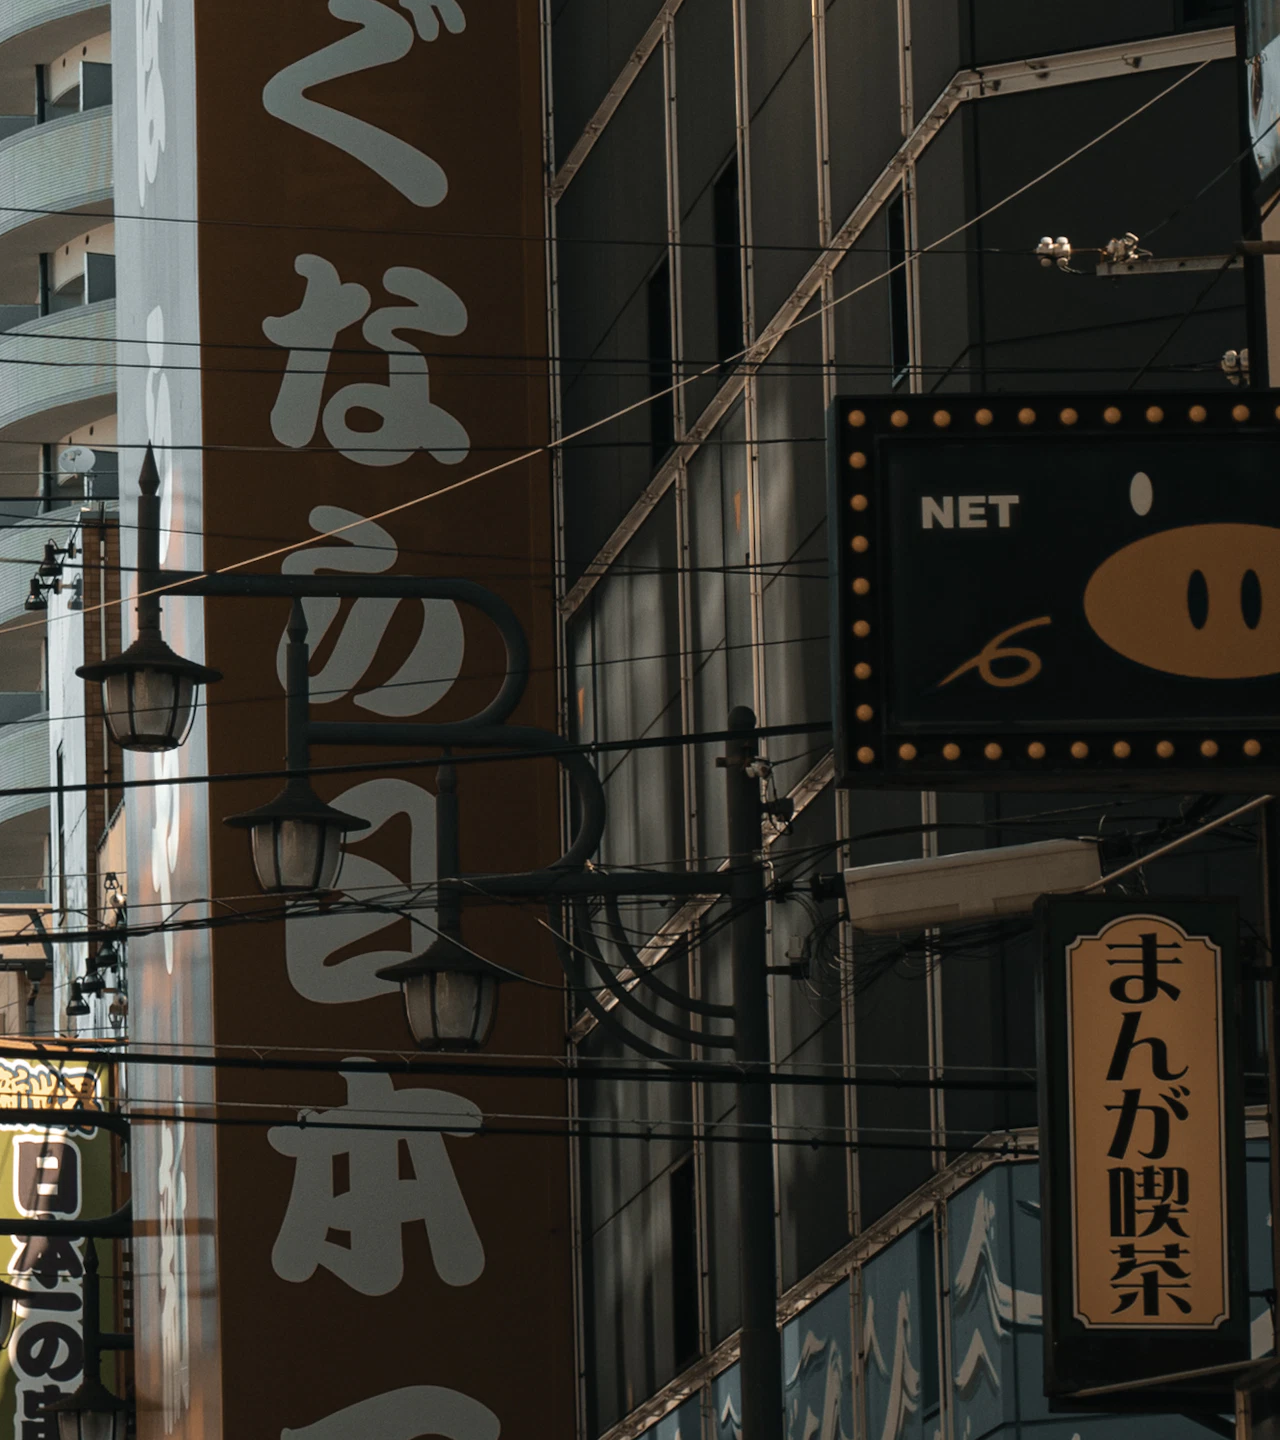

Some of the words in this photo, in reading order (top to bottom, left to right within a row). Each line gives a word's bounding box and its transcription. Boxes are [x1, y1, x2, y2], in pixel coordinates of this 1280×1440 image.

[921, 495, 1019, 529] NET
[1103, 932, 1192, 1318] まんが喫茶
